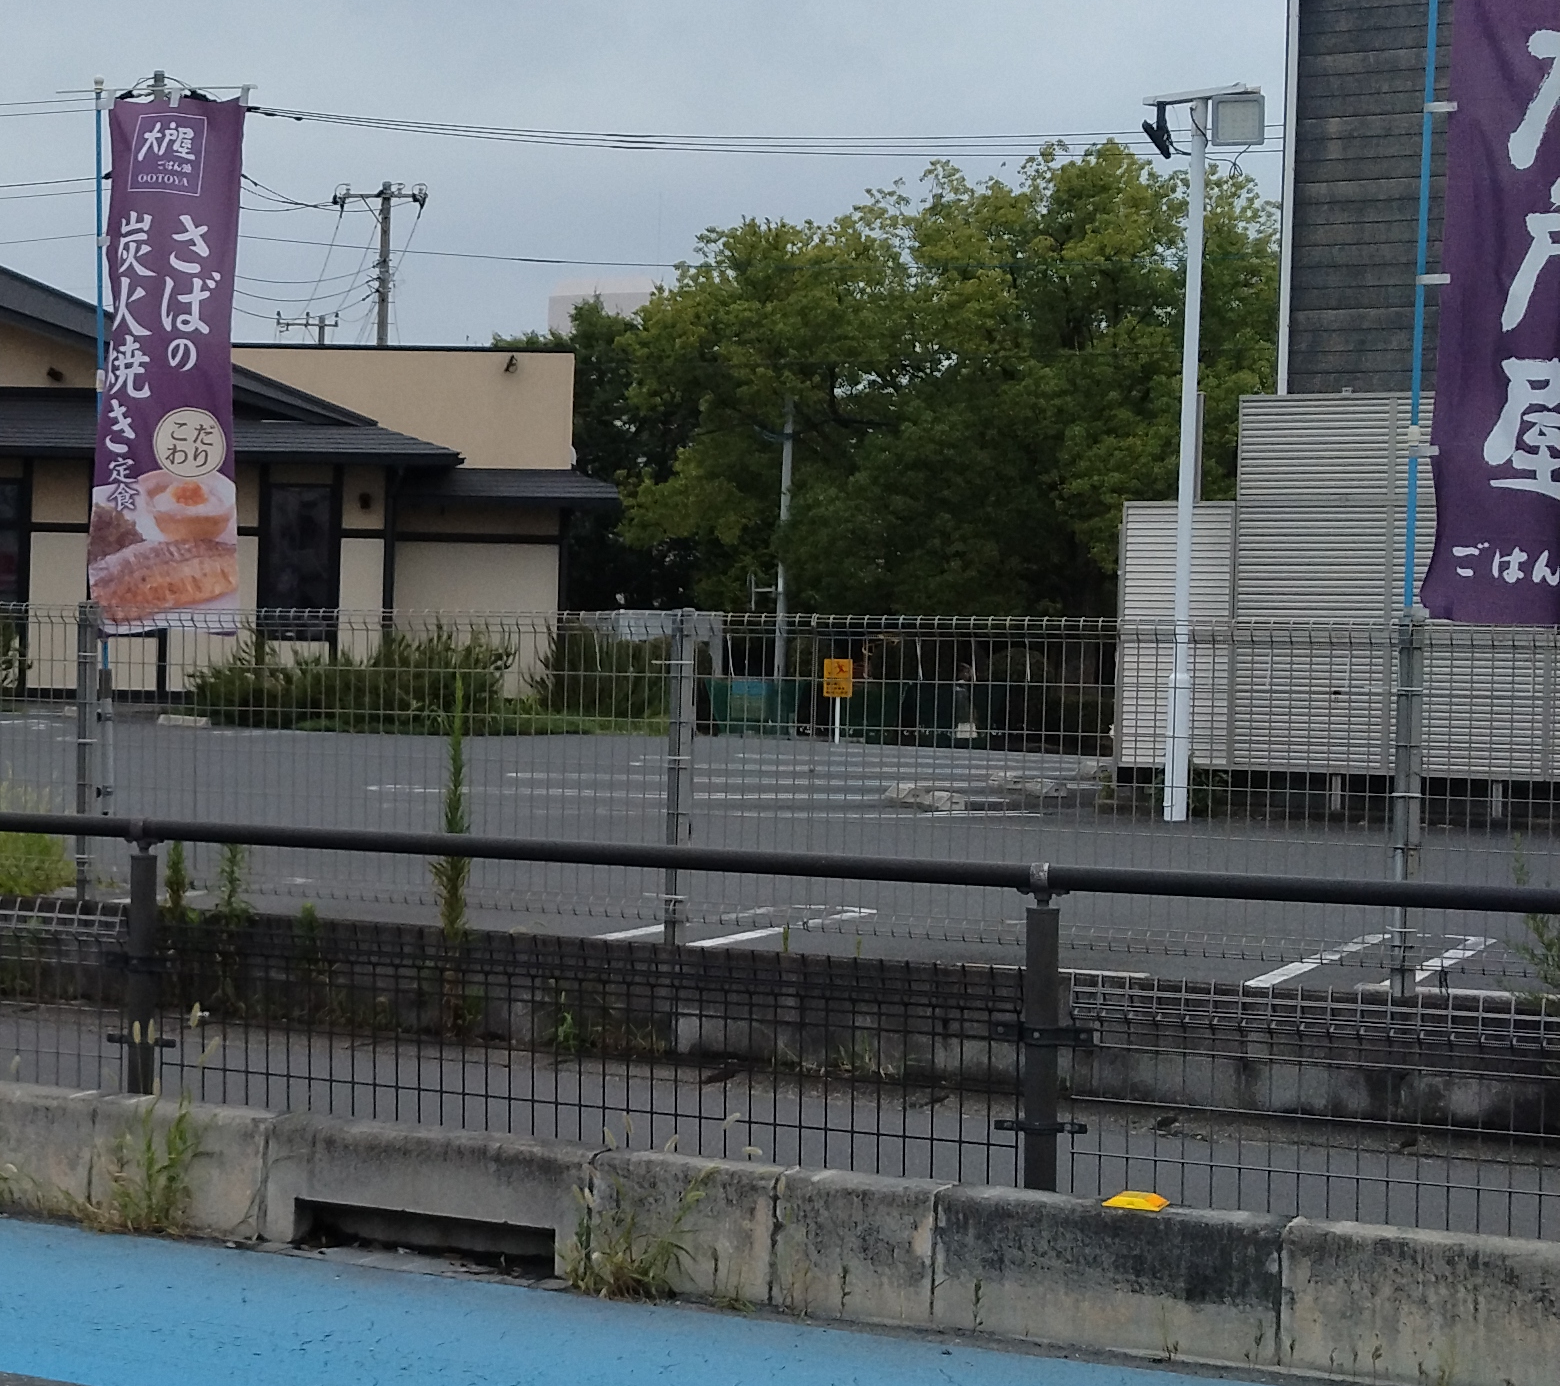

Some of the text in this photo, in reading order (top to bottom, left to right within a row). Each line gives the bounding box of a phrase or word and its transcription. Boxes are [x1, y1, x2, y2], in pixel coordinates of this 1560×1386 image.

[138, 121, 196, 162] 大戸屋
[138, 173, 189, 187] OOTOYA
[161, 215, 221, 372] さばの
